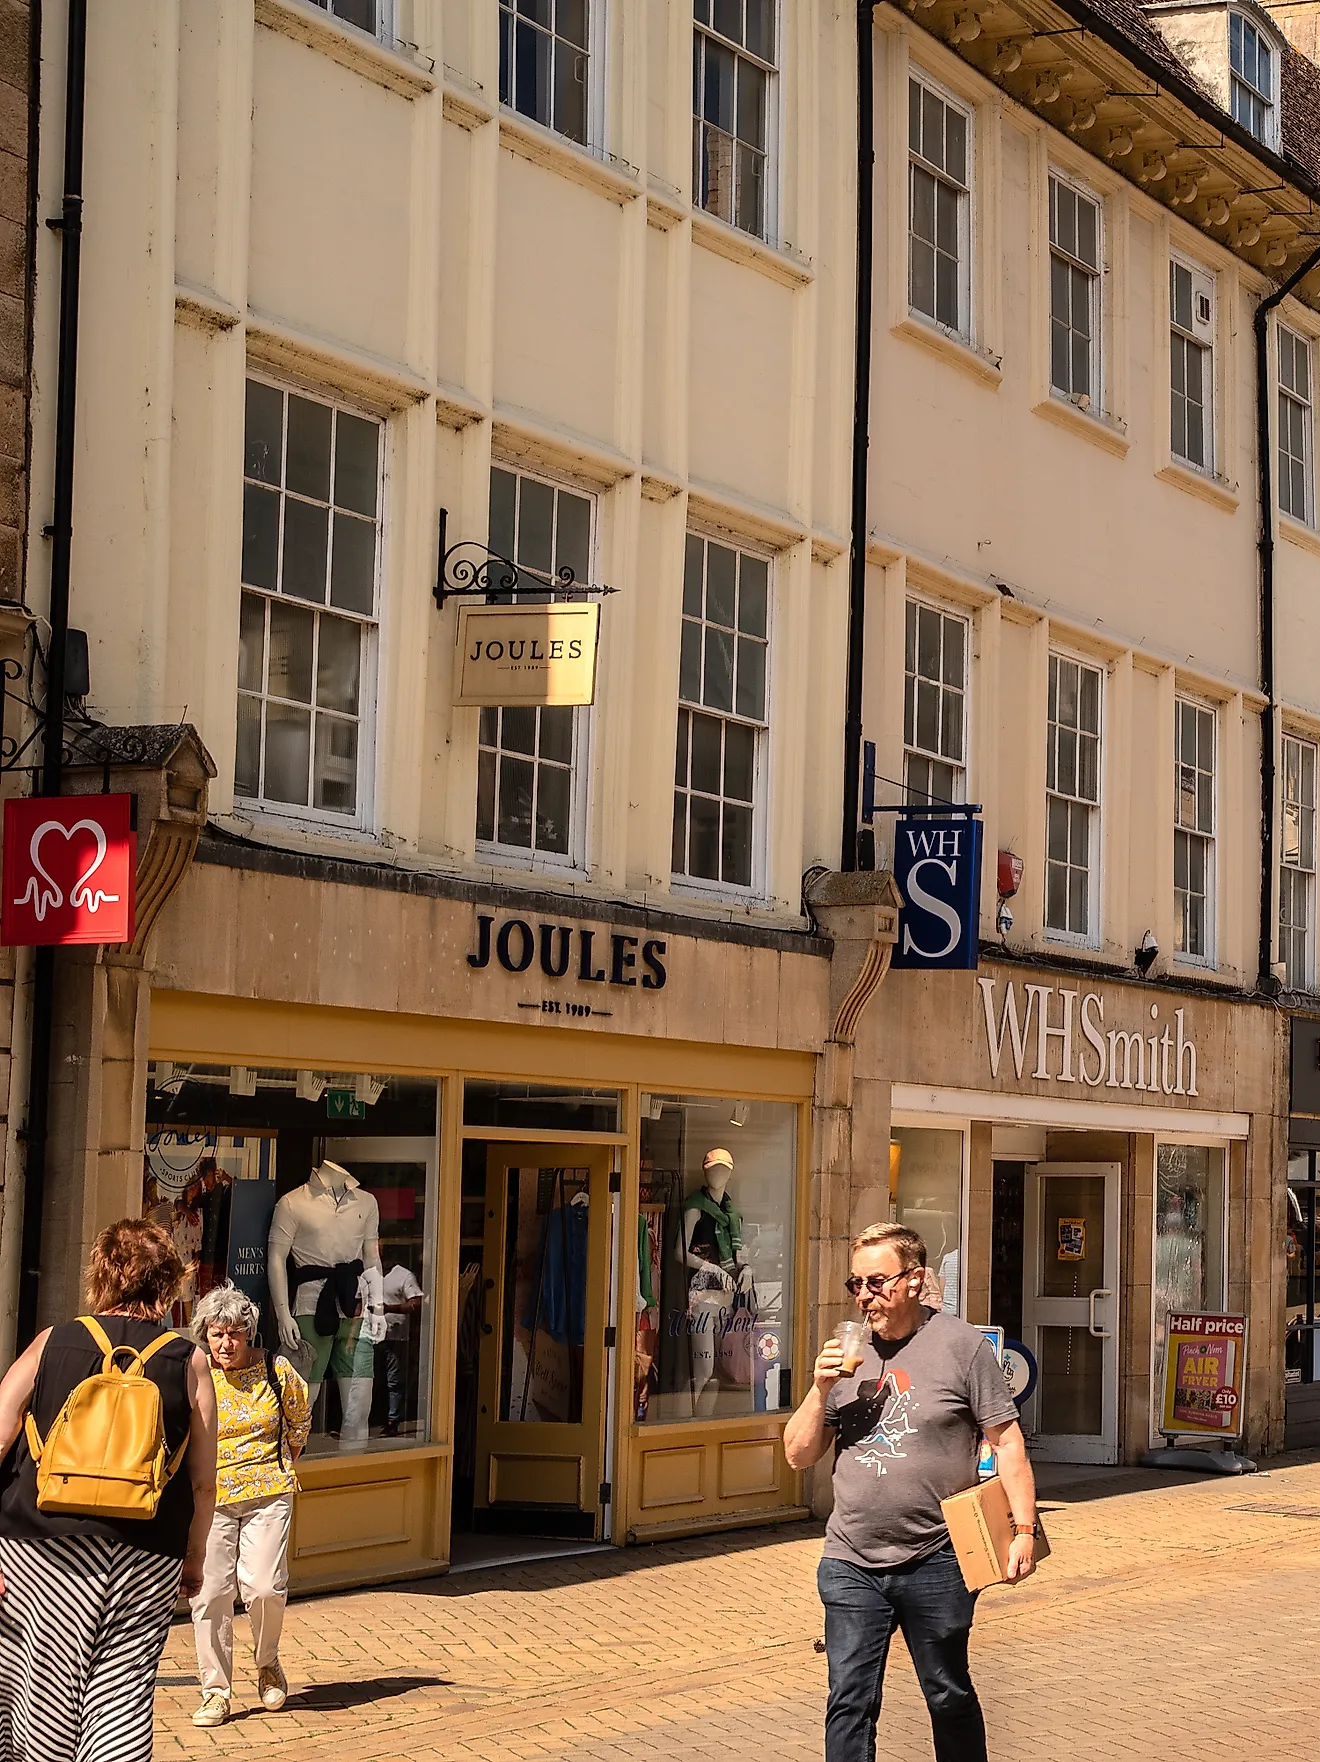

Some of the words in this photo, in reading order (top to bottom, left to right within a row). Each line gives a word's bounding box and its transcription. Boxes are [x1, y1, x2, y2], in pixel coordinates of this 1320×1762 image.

[469, 639, 582, 661] JOULES
[906, 829, 963, 857] WH
[903, 858, 962, 958] S
[466, 915, 667, 990] JOULES
[541, 1000, 562, 1014] EST.
[566, 1002, 591, 1018] 1989
[976, 976, 1200, 1097] WHSmith
[237, 1246, 264, 1259] MEN'S
[234, 1262, 265, 1276] SHIRTS
[668, 1308, 711, 1337] Well
[712, 1306, 759, 1340] Spent
[1170, 1316, 1203, 1332] Half
[1204, 1318, 1244, 1335] price
[1183, 1357, 1219, 1375] AIR
[1182, 1375, 1219, 1387] FRYER
[1215, 1394, 1237, 1405] £10
